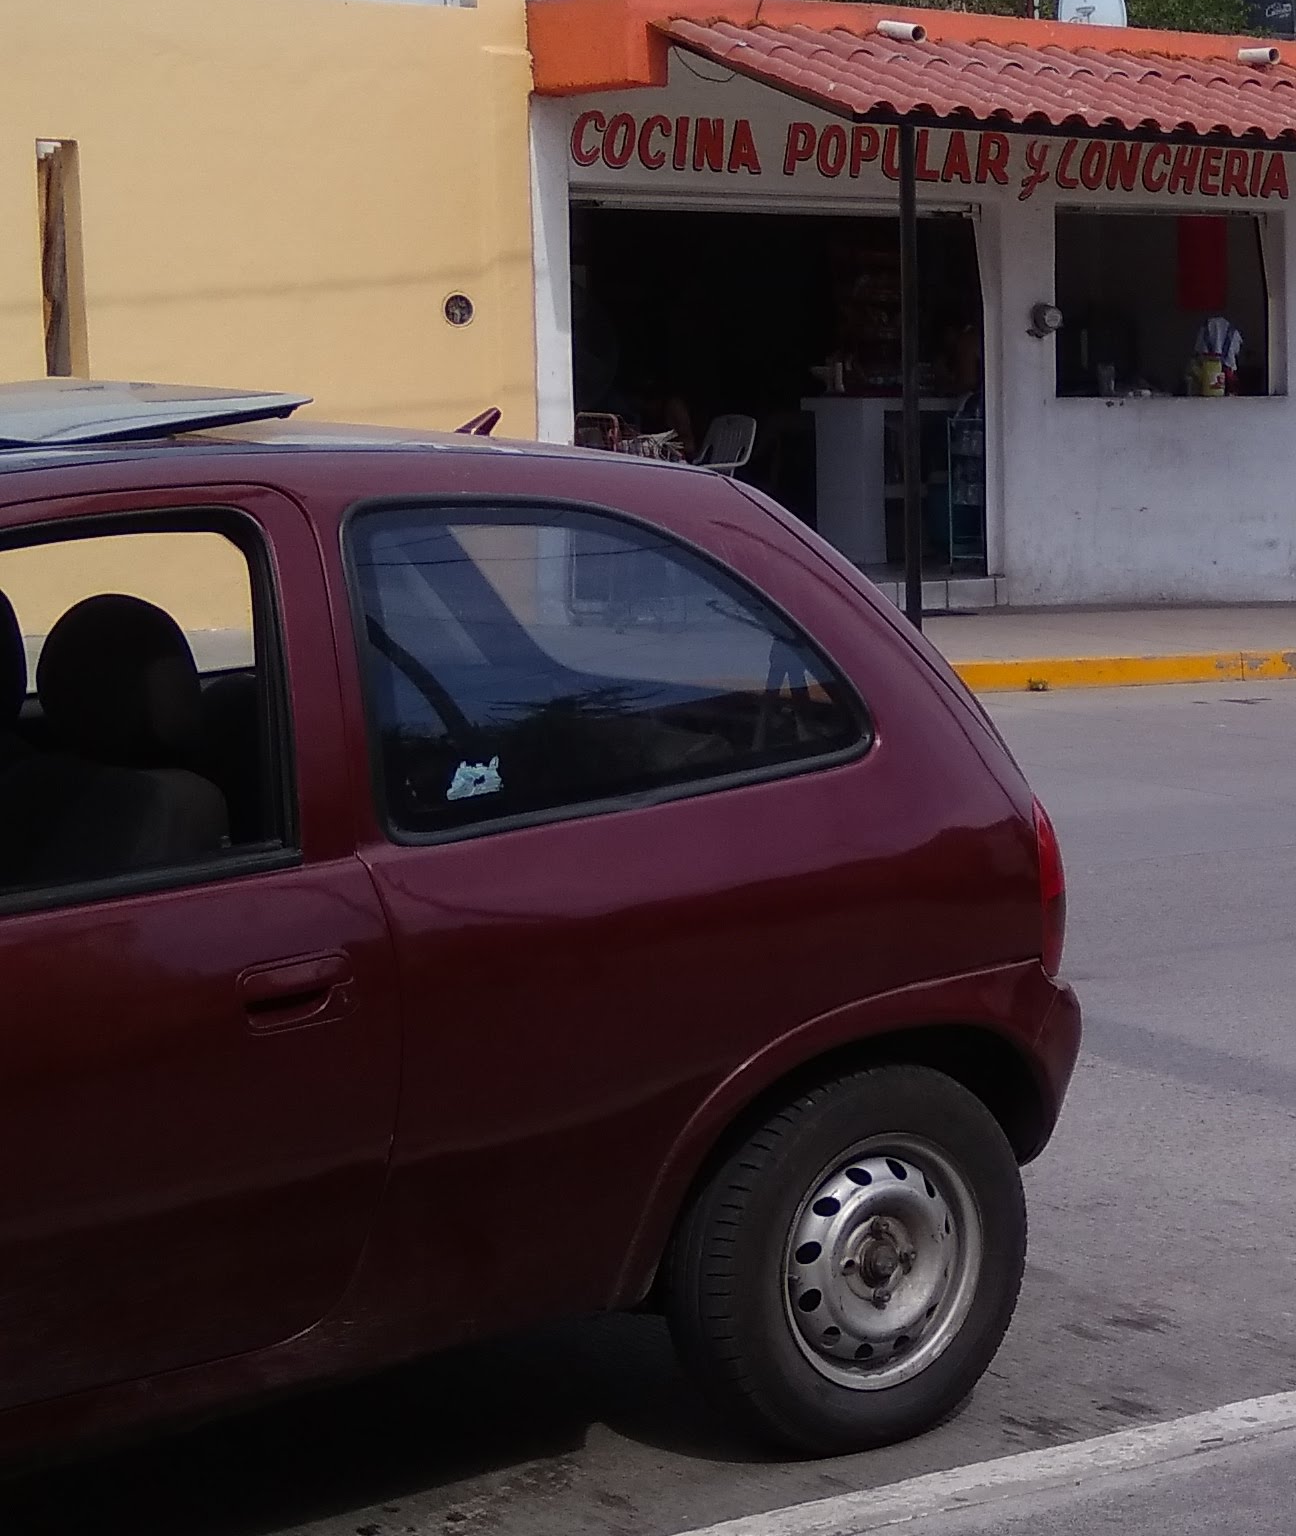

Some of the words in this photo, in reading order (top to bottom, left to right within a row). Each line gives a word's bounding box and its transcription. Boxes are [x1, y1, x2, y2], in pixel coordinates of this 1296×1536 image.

[570, 110, 762, 175] COCINA
[783, 122, 1009, 184] POPULAR
[1055, 138, 1290, 200] LONCHERIA
